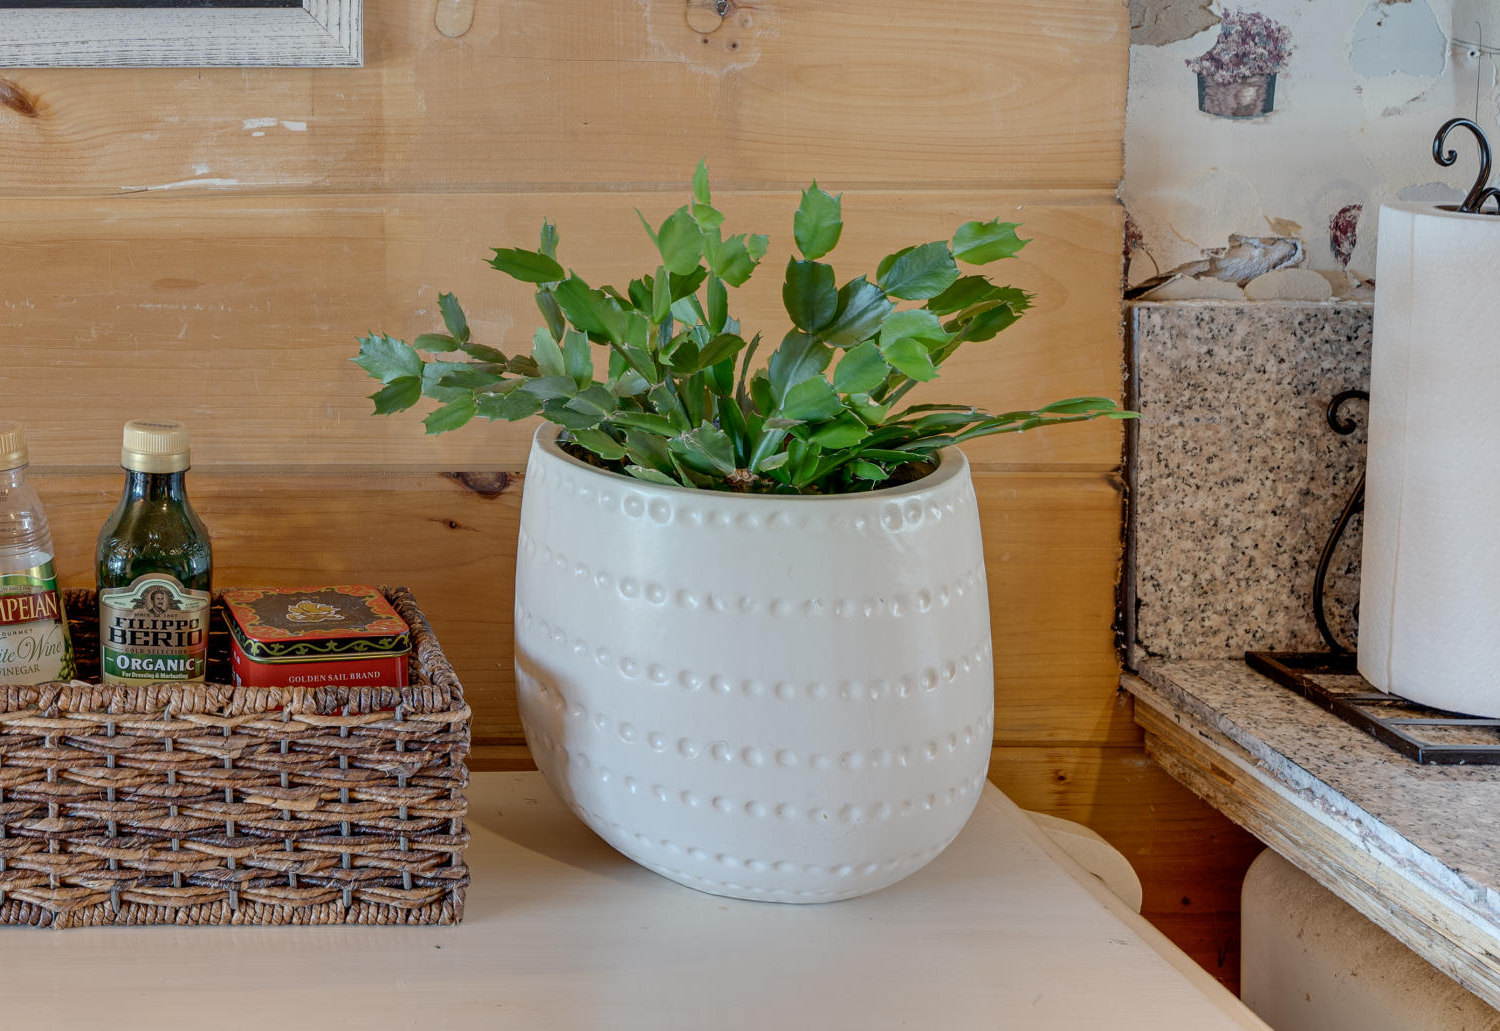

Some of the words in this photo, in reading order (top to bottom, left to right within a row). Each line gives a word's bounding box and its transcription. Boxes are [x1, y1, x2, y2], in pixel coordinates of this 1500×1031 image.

[115, 617, 200, 631] FILIPPO
[17, 625, 62, 663] Wine
[108, 626, 204, 647] BERIO
[116, 654, 196, 672] ORGANIC
[288, 674, 326, 683] GOLDEN
[328, 673, 348, 682] SAIL
[350, 671, 381, 680] BRAND
